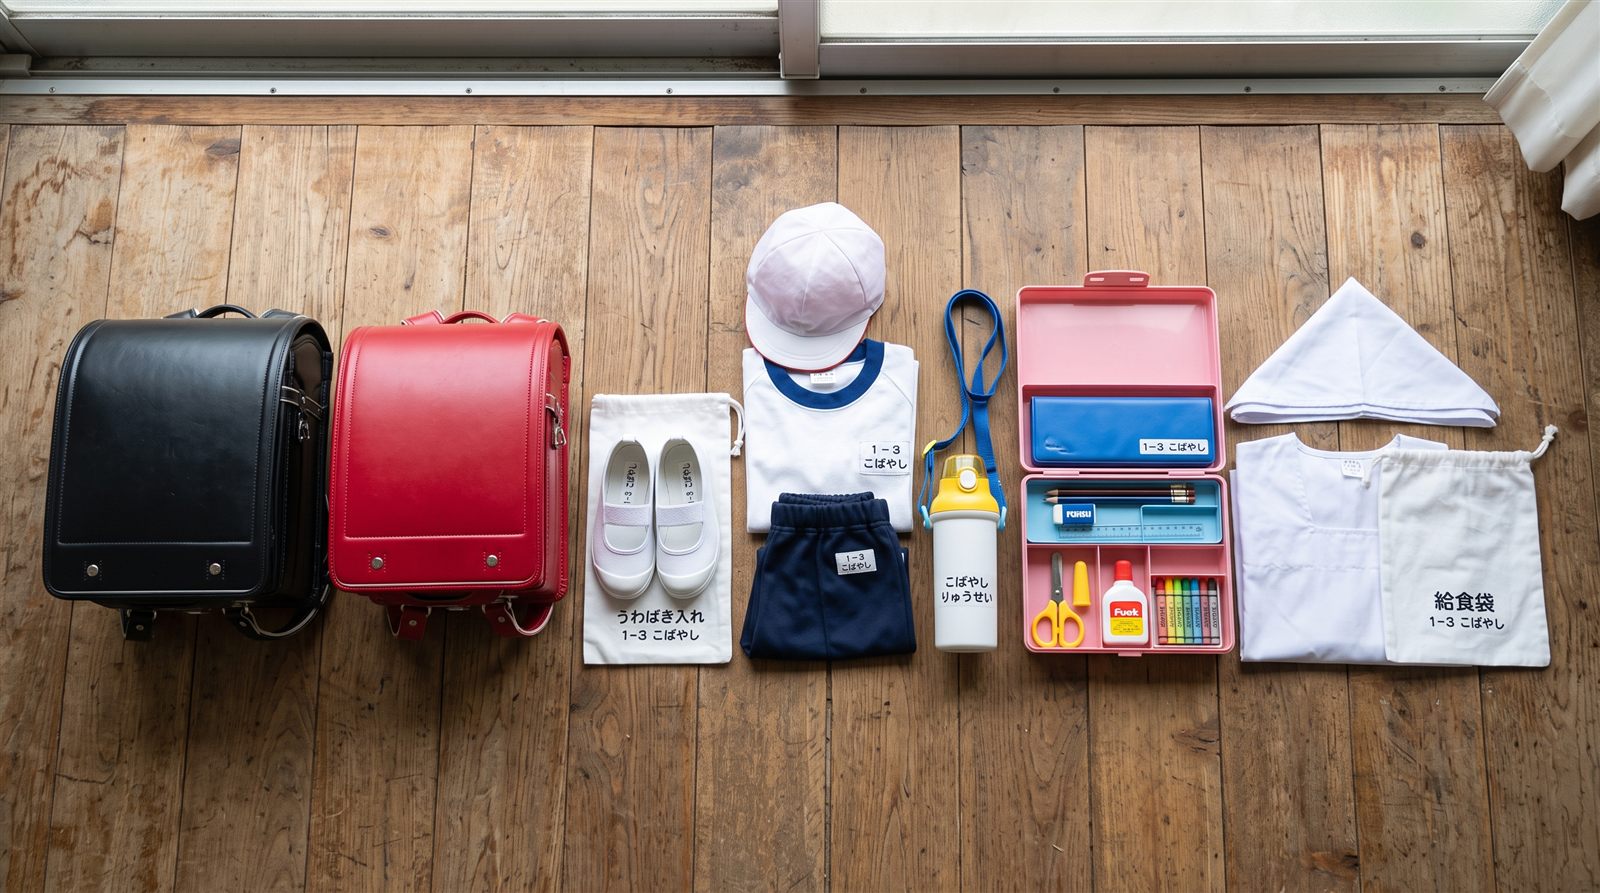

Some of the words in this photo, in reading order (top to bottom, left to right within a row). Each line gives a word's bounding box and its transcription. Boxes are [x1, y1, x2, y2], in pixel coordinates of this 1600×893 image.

[871, 445, 901, 454] 1-3
[1143, 442, 1164, 452] 1-3
[1169, 442, 1206, 452] こばやし
[864, 458, 907, 469] こばやし
[846, 553, 865, 562] 1-3
[842, 561, 871, 571] こばやし
[946, 576, 988, 588] こばやし
[942, 591, 992, 603] りゅうせい
[1434, 591, 1495, 612] 給食袋
[617, 609, 705, 624] うわばき入れ
[1429, 616, 1455, 627] 1-3
[1460, 617, 1505, 629] こばやし
[622, 630, 647, 640] 1-3
[653, 629, 700, 640] こばやし
